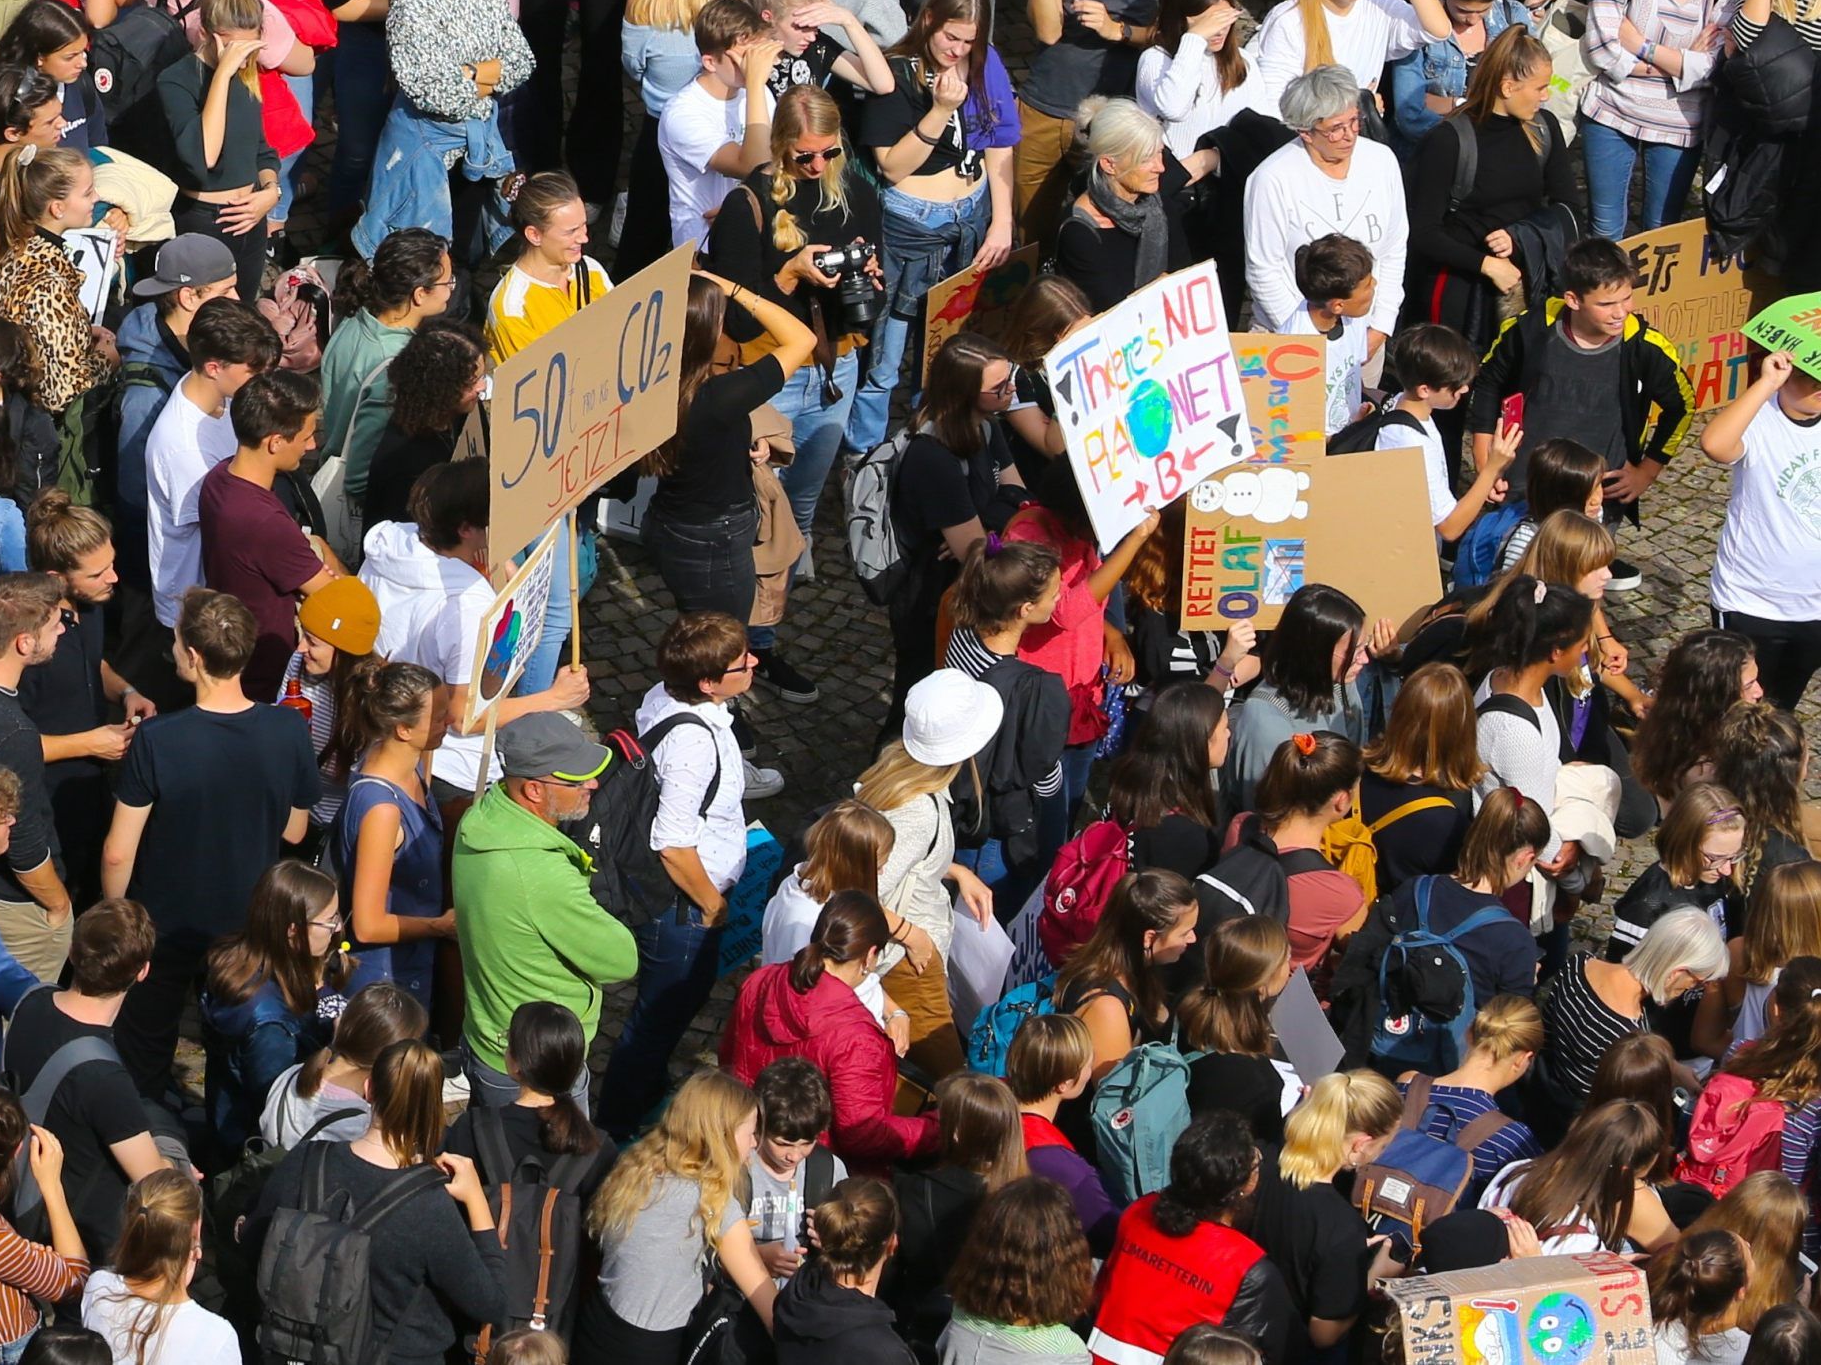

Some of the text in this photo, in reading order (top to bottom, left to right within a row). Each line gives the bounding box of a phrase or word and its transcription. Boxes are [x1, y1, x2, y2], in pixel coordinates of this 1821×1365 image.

[1055, 275, 1217, 415] There's NO
[1709, 332, 1744, 362] TH
[547, 403, 623, 508] JETZT
[1154, 451, 1182, 501] B
[1186, 526, 1218, 618] RETTET
[1217, 525, 1262, 619] OLAF
[747, 1195, 806, 1216] OPENIG
[1122, 1239, 1214, 1296] LIMARETTERIN
